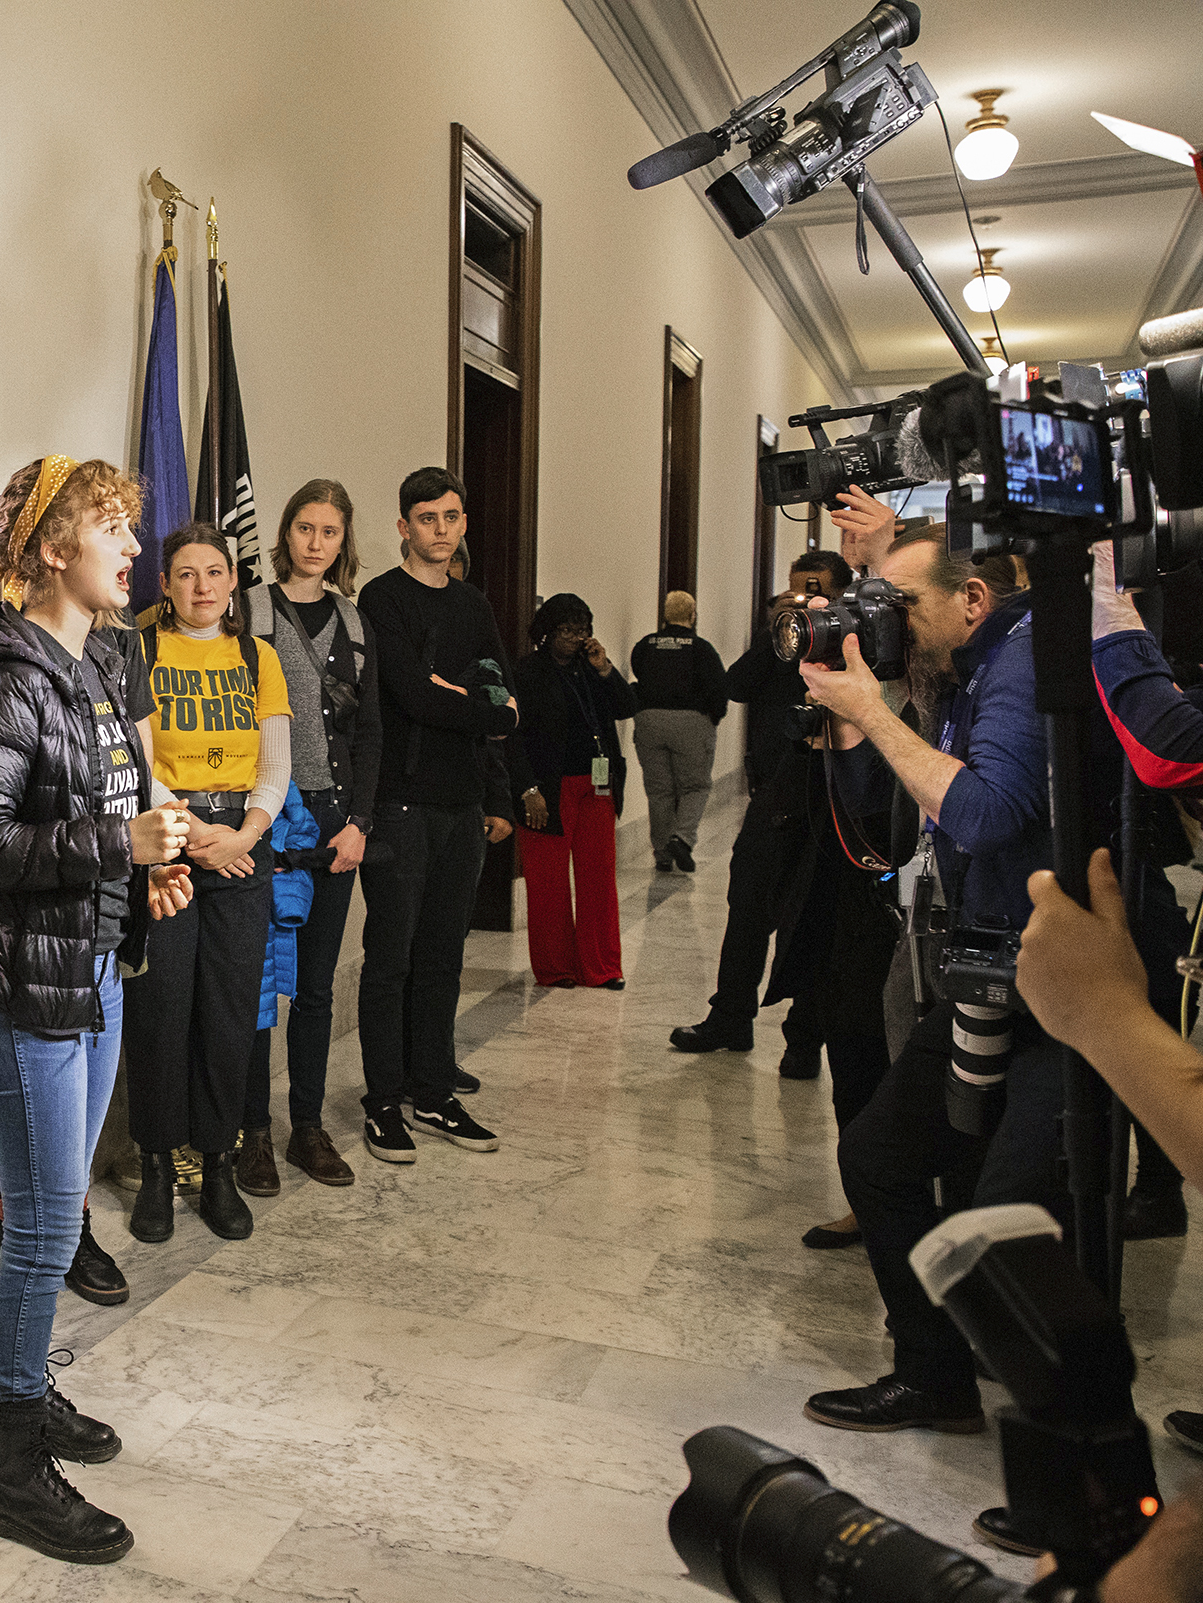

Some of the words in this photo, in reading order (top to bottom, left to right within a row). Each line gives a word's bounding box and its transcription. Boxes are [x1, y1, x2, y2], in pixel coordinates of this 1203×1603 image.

[153, 667, 204, 696] OUR
[159, 696, 198, 731] TO
[202, 694, 260, 731] RISE
[110, 748, 130, 767] AND
